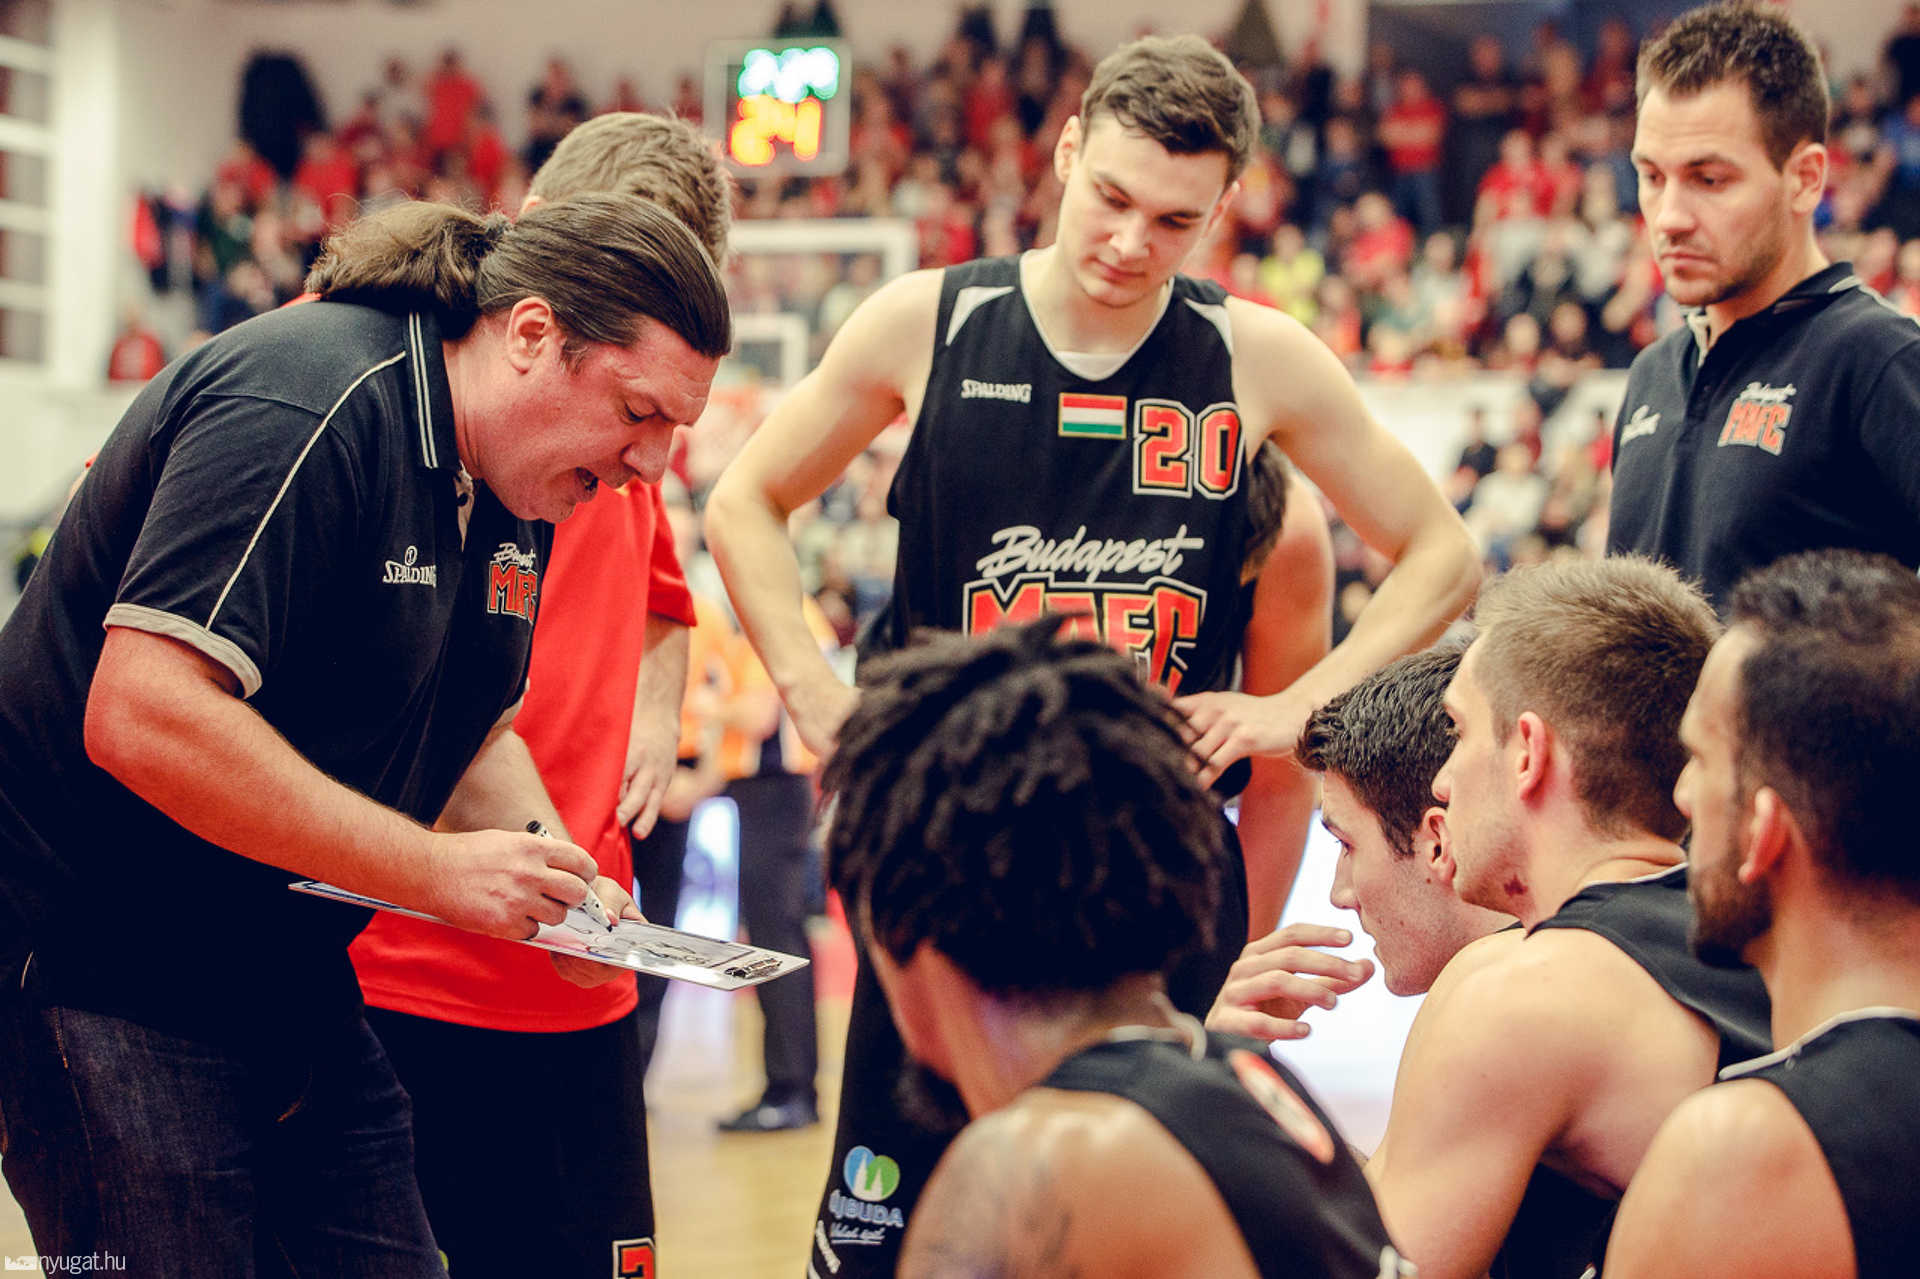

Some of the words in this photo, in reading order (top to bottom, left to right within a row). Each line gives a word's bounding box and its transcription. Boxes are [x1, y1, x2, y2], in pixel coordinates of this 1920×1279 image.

[961, 378, 1032, 403] SPALDING
[1133, 398, 1246, 500] 20
[1717, 400, 1792, 456] MAFC
[976, 524, 1204, 584] Budapest
